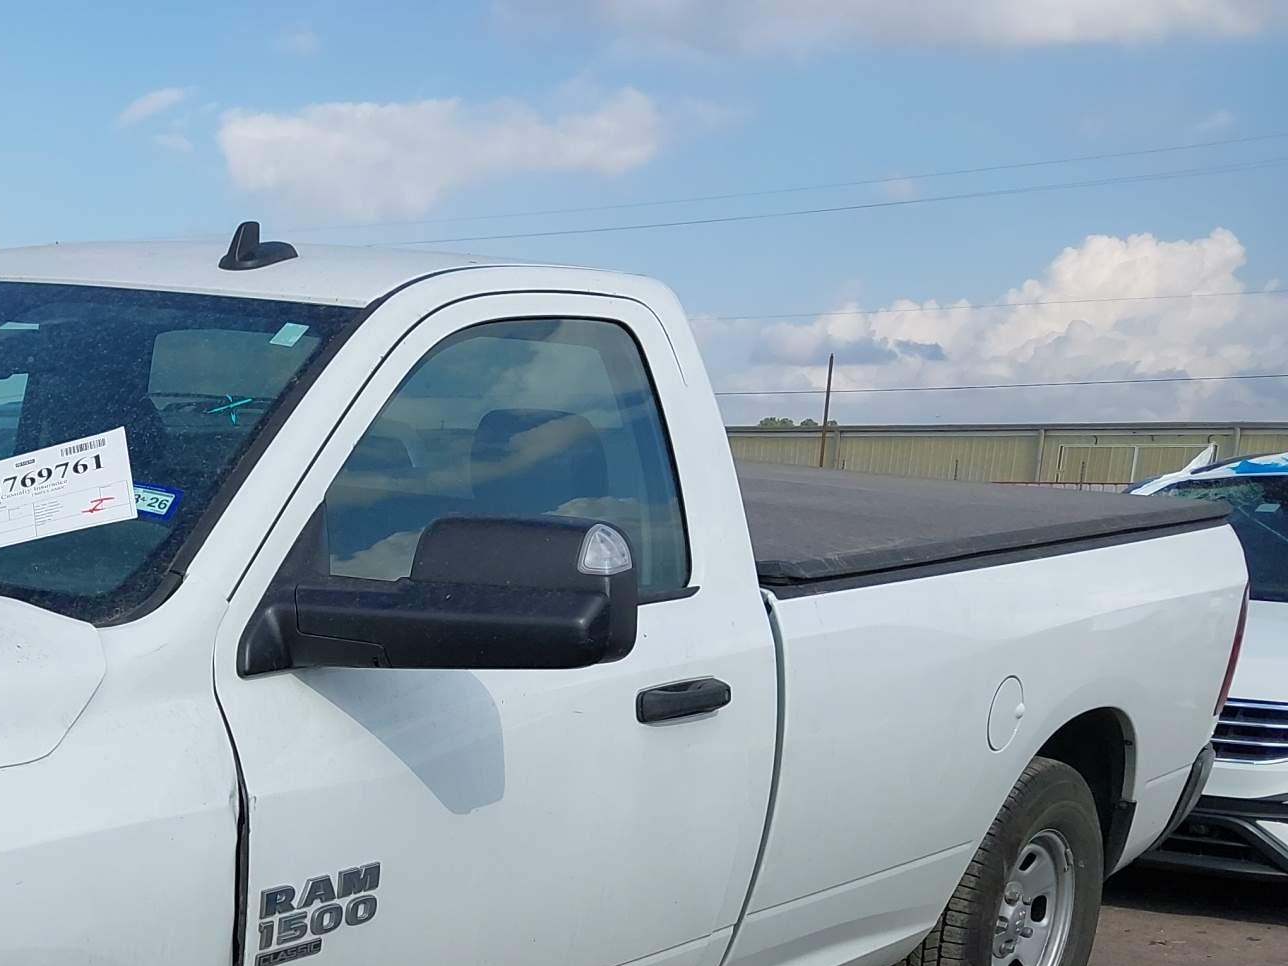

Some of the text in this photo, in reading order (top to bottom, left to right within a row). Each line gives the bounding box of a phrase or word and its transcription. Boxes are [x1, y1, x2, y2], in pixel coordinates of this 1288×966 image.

[146, 496, 169, 511] 26
[259, 861, 381, 919] RAM
[258, 894, 378, 951] 1500
